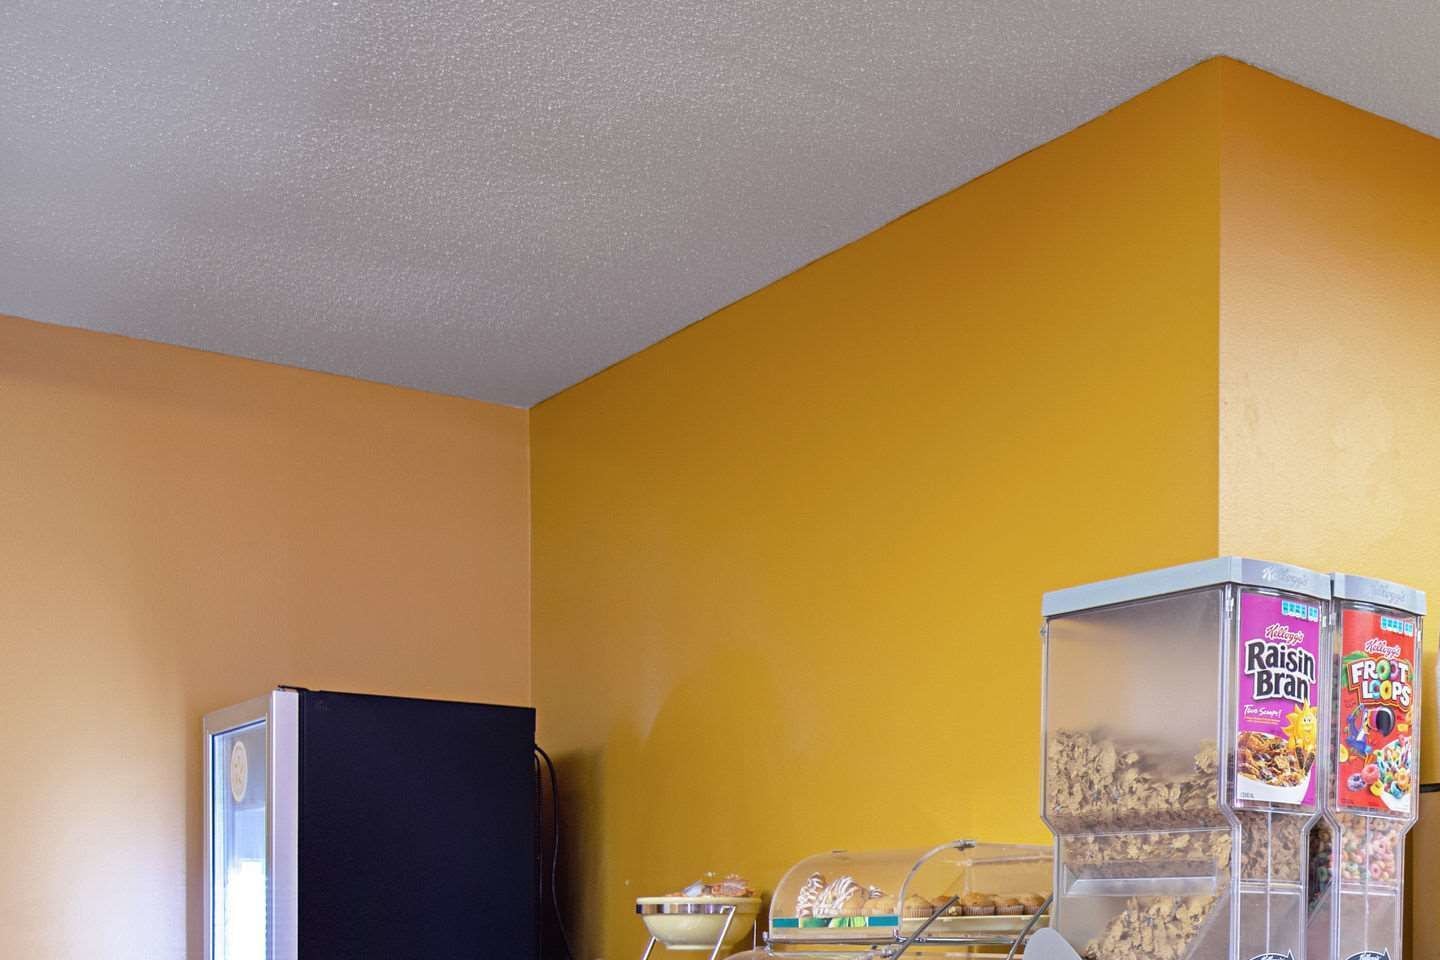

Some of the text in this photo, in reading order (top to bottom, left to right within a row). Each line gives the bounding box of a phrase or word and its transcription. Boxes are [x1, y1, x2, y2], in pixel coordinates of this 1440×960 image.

[1265, 624, 1304, 645] Kellogg's
[1247, 641, 1314, 681] Raisin
[1365, 638, 1401, 659] Kellogg's
[1256, 669, 1308, 699] Bran
[1351, 659, 1409, 684] FROOT
[1362, 680, 1412, 706] LOOPS
